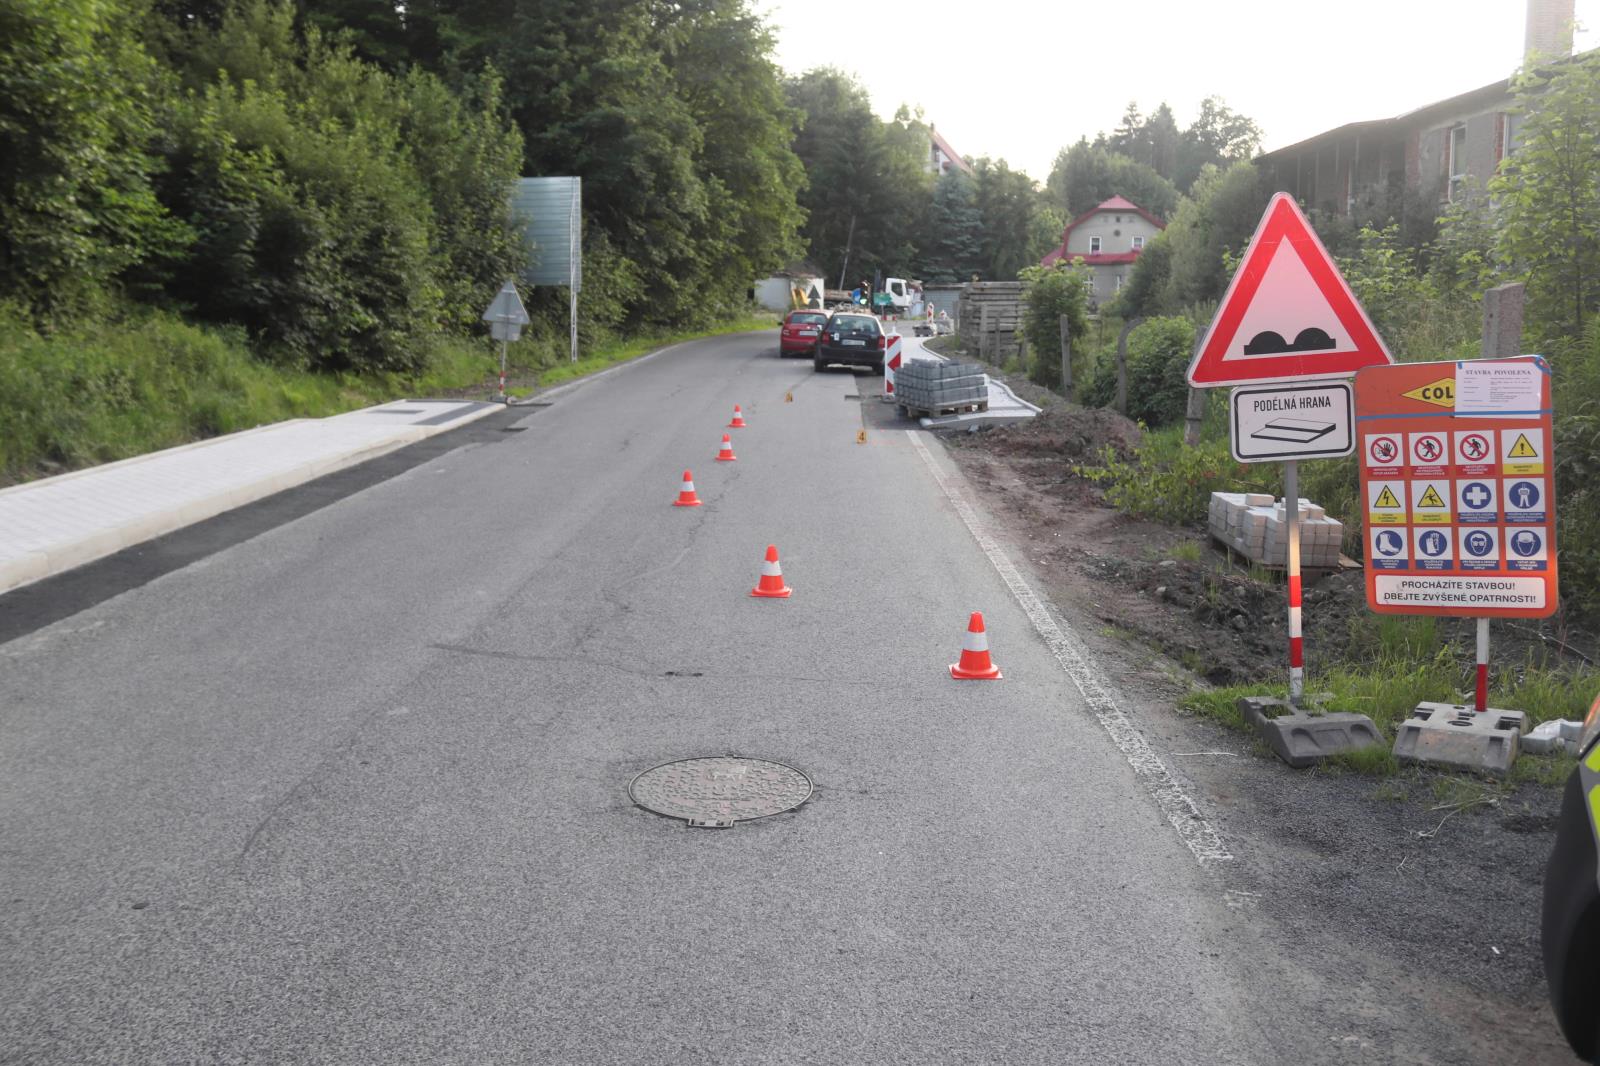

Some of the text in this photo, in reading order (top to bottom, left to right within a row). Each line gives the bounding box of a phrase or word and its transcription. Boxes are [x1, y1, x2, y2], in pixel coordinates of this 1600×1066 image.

[1494, 368, 1532, 376] POVOLENA
[1254, 395, 1331, 412] PODÉLNÁ HRANA
[1402, 580, 1515, 590] PROCHÁZÍTE STAVBOU!
[1384, 592, 1536, 603] DBEJTE ZVÝŠENÉ OPATRNOSTI!
